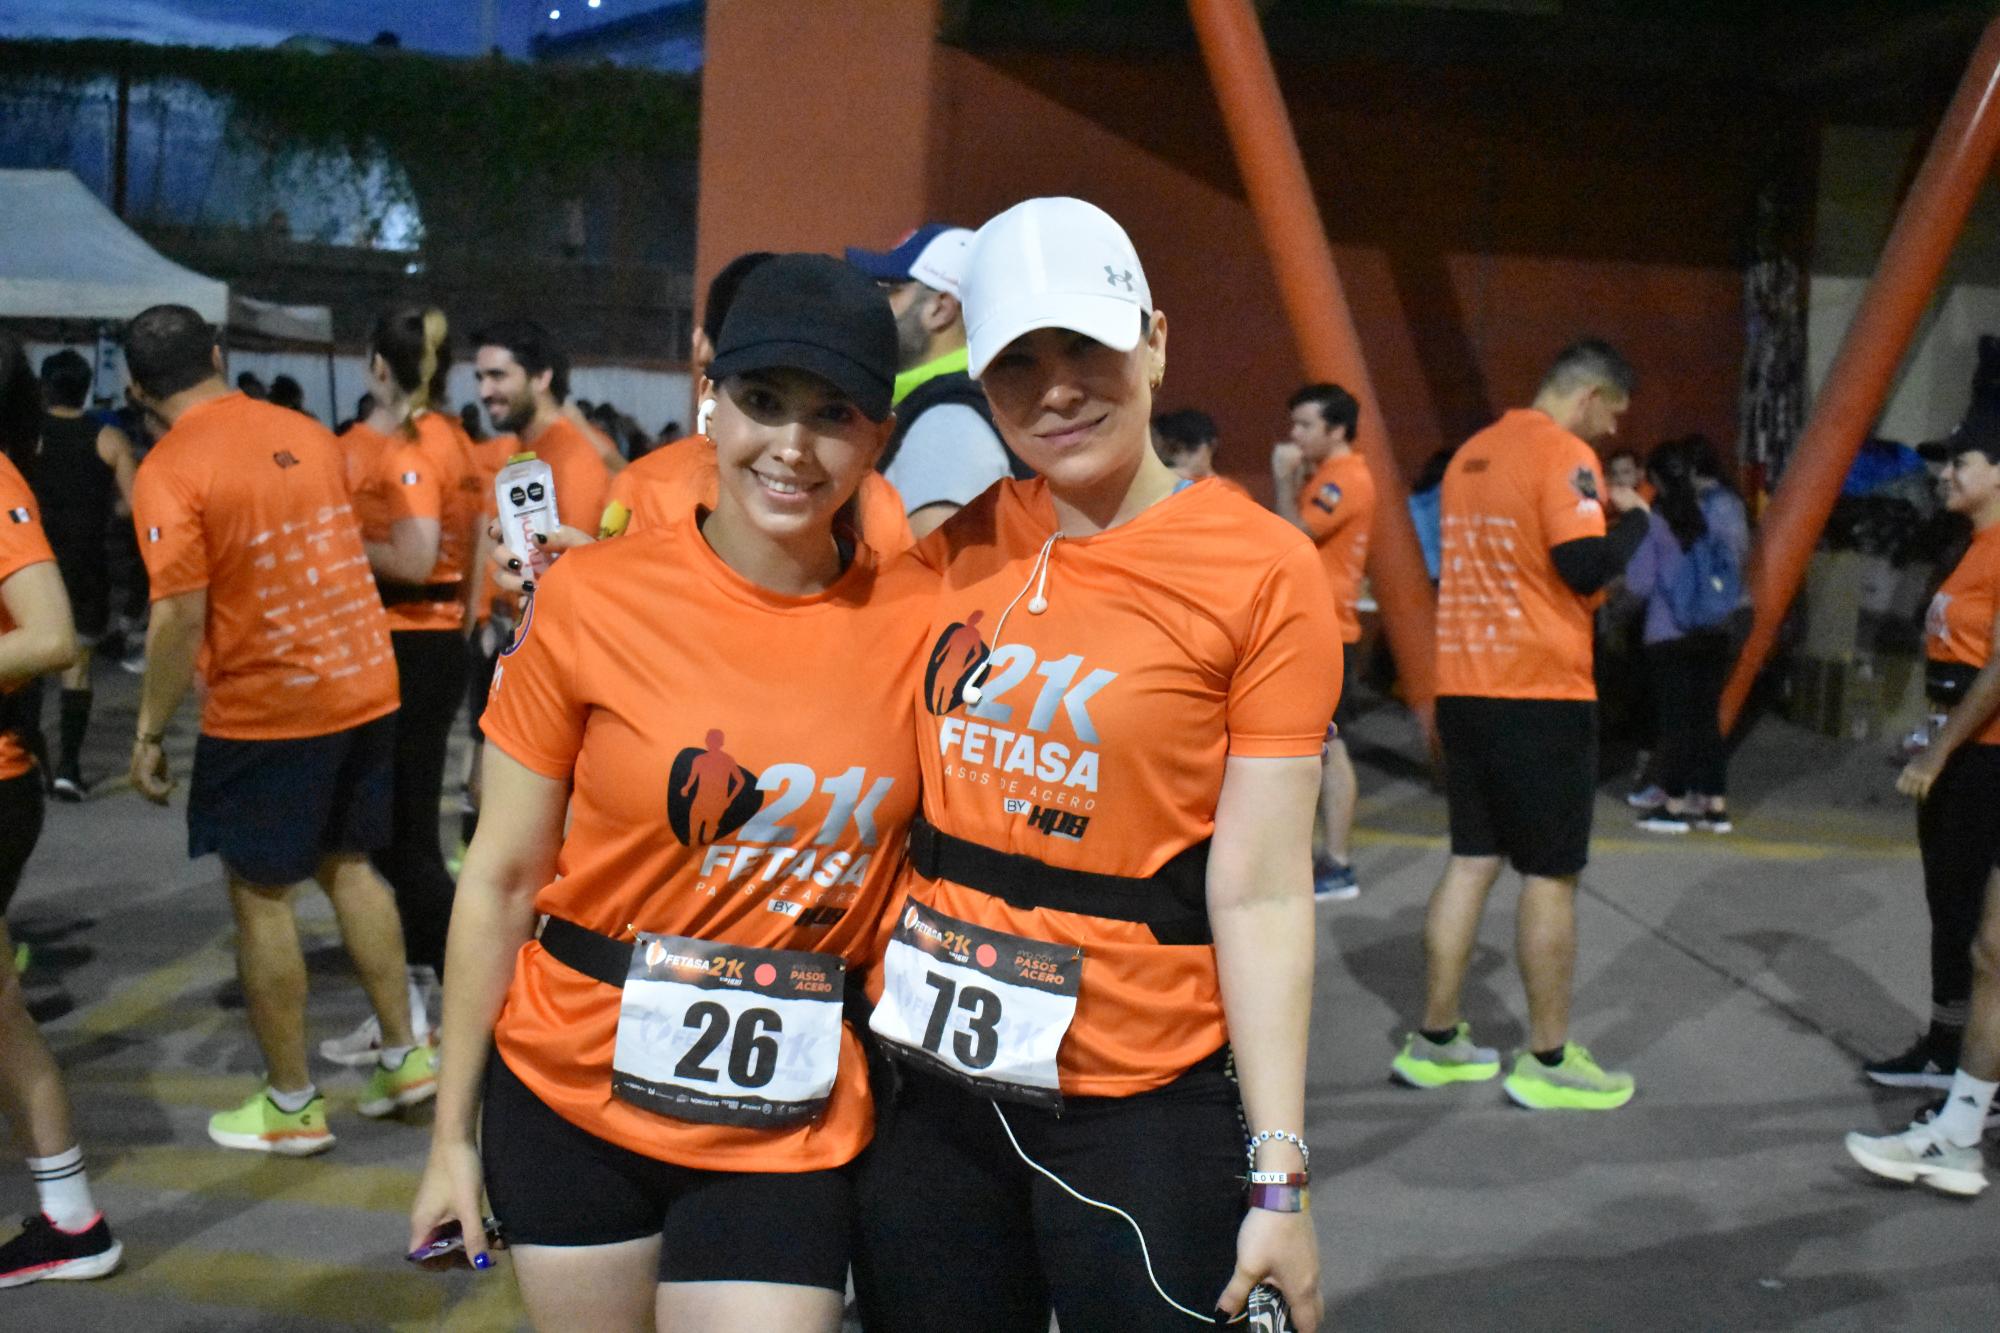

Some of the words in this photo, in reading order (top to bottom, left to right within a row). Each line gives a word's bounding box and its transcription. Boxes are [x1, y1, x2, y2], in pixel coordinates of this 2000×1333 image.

[965, 643, 1120, 745] 21K
[938, 716, 1100, 792] FETASA
[944, 764, 990, 785] ASOS
[736, 762, 896, 847] 21K
[1006, 799, 1026, 813] BY
[771, 900, 796, 914] BY
[941, 931, 973, 956] 21K
[664, 953, 711, 972] FETASA
[710, 956, 746, 979] 21K
[1014, 956, 1059, 974] PASOS
[789, 969, 827, 983] PASOS
[794, 980, 833, 993] ACERO
[1019, 967, 1065, 986] ACERO
[921, 969, 1003, 1070] 73
[673, 1000, 783, 1089] 26
[1253, 1174, 1285, 1182] LOVE
